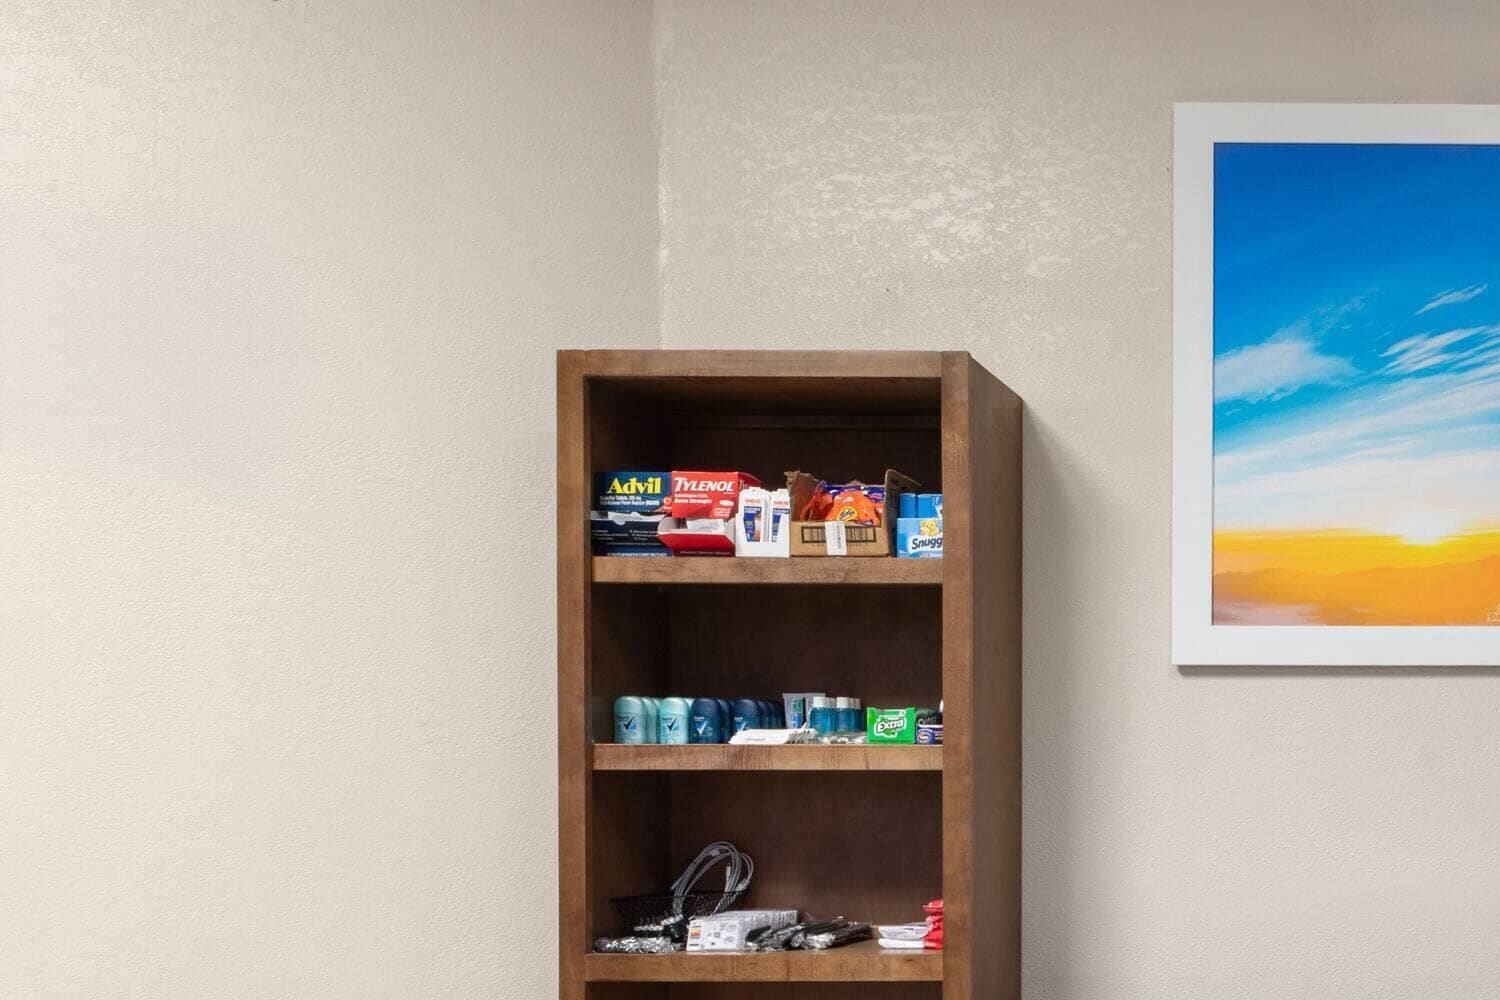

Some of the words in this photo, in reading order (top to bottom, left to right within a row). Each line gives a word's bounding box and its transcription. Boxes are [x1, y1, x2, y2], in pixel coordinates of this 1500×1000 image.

[606, 477, 661, 494] Advil
[674, 477, 735, 492] TYLENOL
[912, 537, 943, 549] Snugg
[876, 719, 904, 733] Extra
